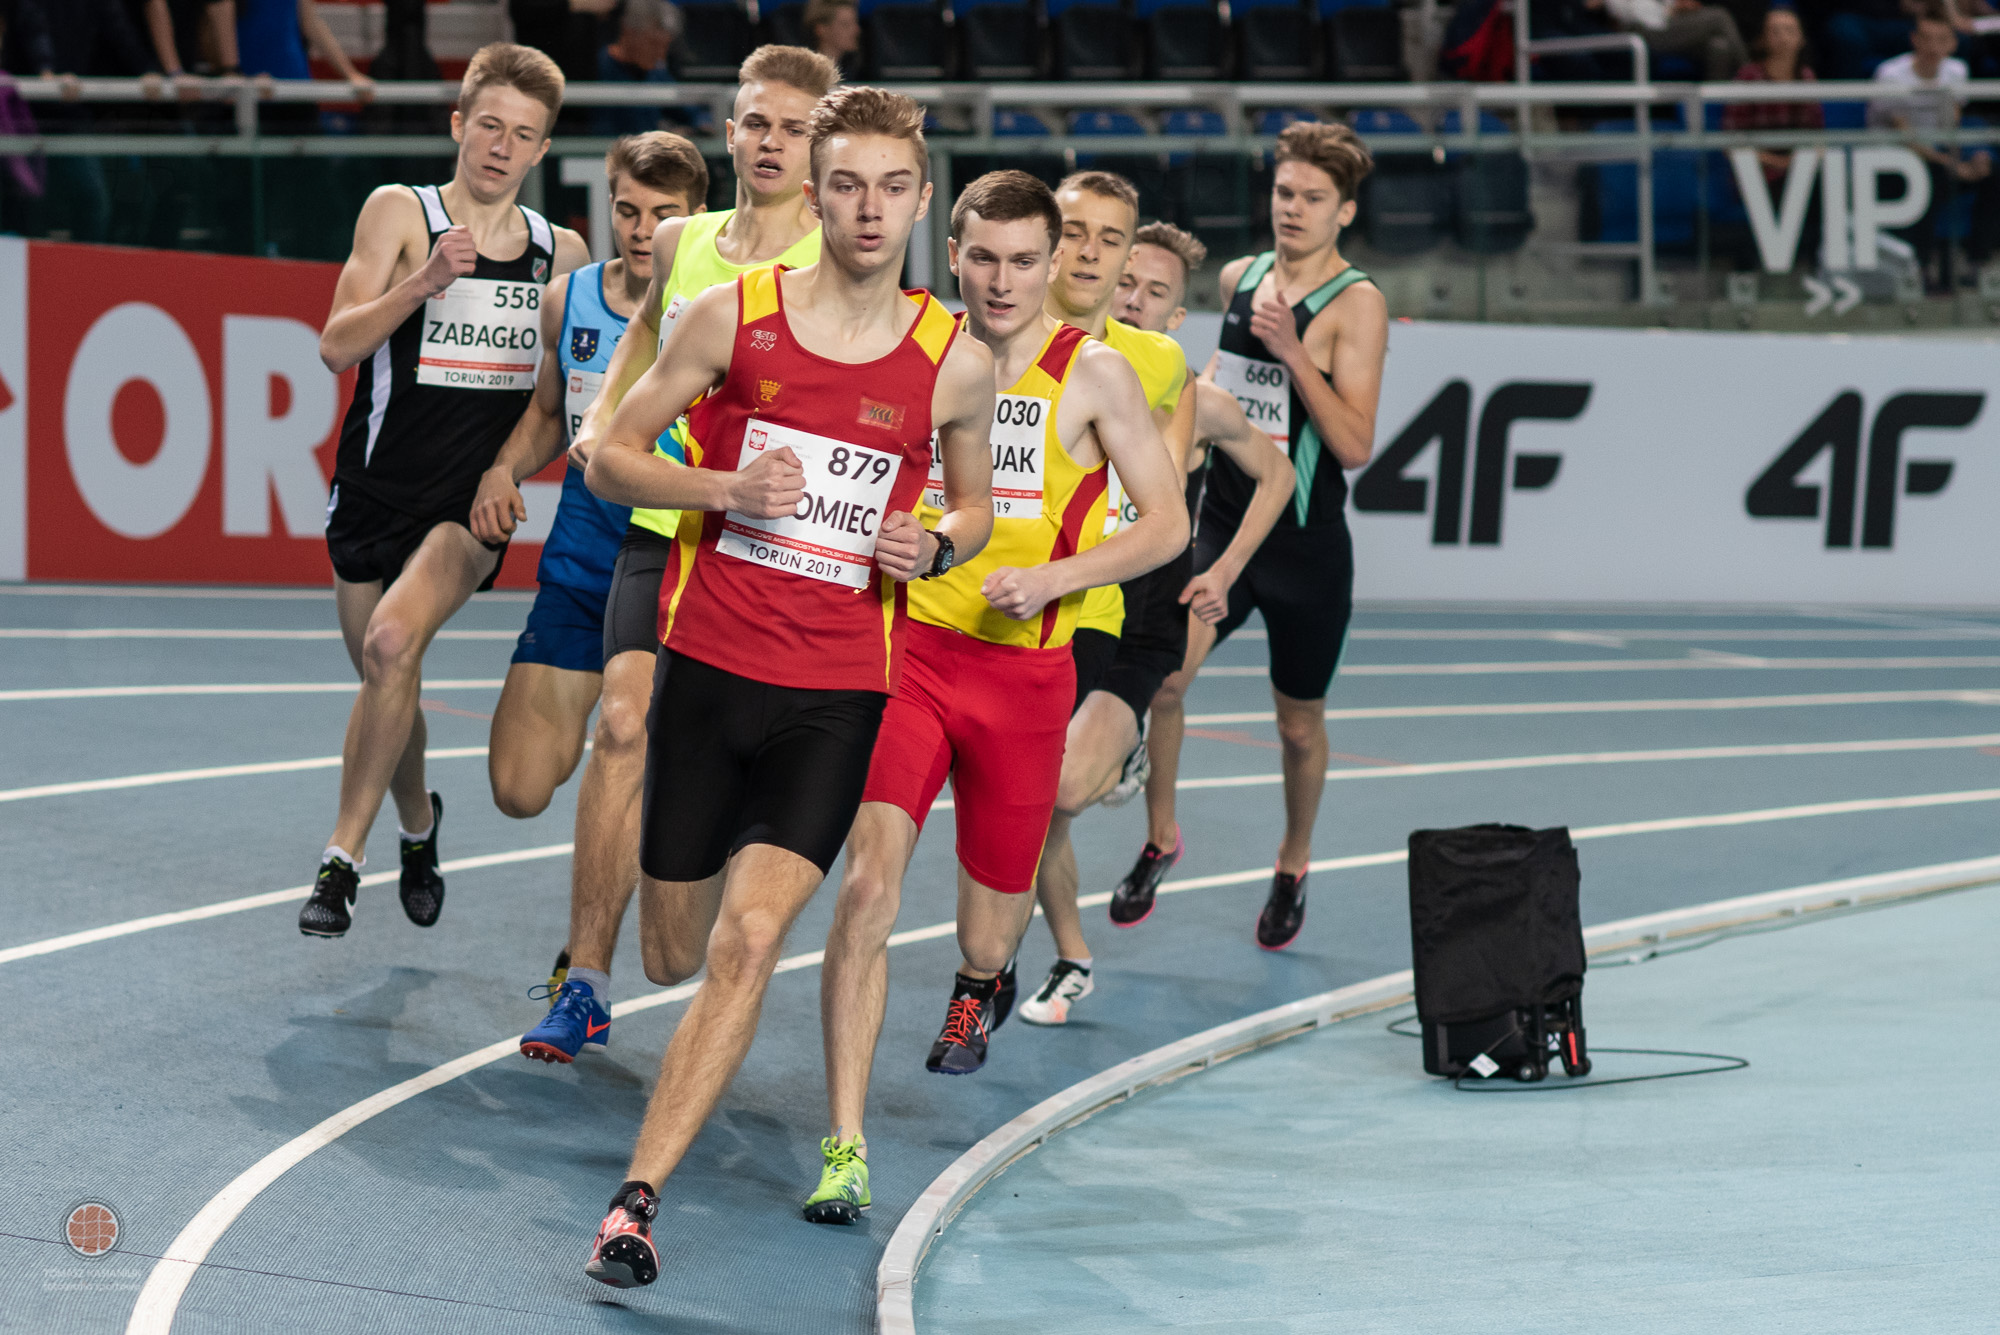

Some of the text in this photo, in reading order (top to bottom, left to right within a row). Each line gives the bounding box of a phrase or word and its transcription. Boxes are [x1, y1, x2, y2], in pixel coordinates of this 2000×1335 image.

[1729, 147, 1931, 274] VIP
[494, 285, 539, 311] 558
[427, 320, 537, 350] ZABAGŁO
[445, 370, 514, 386] TORUŃ 2019
[1245, 364, 1282, 387] 660
[828, 446, 891, 485] 879
[1352, 379, 1594, 546] 4F
[1745, 390, 1986, 549] 4F
[745, 529, 773, 541] HALOWE
[772, 537, 821, 553] MISTRZOSTWA
[821, 548, 844, 559] POLSKI
[749, 543, 842, 578] TORUŃ 2019
